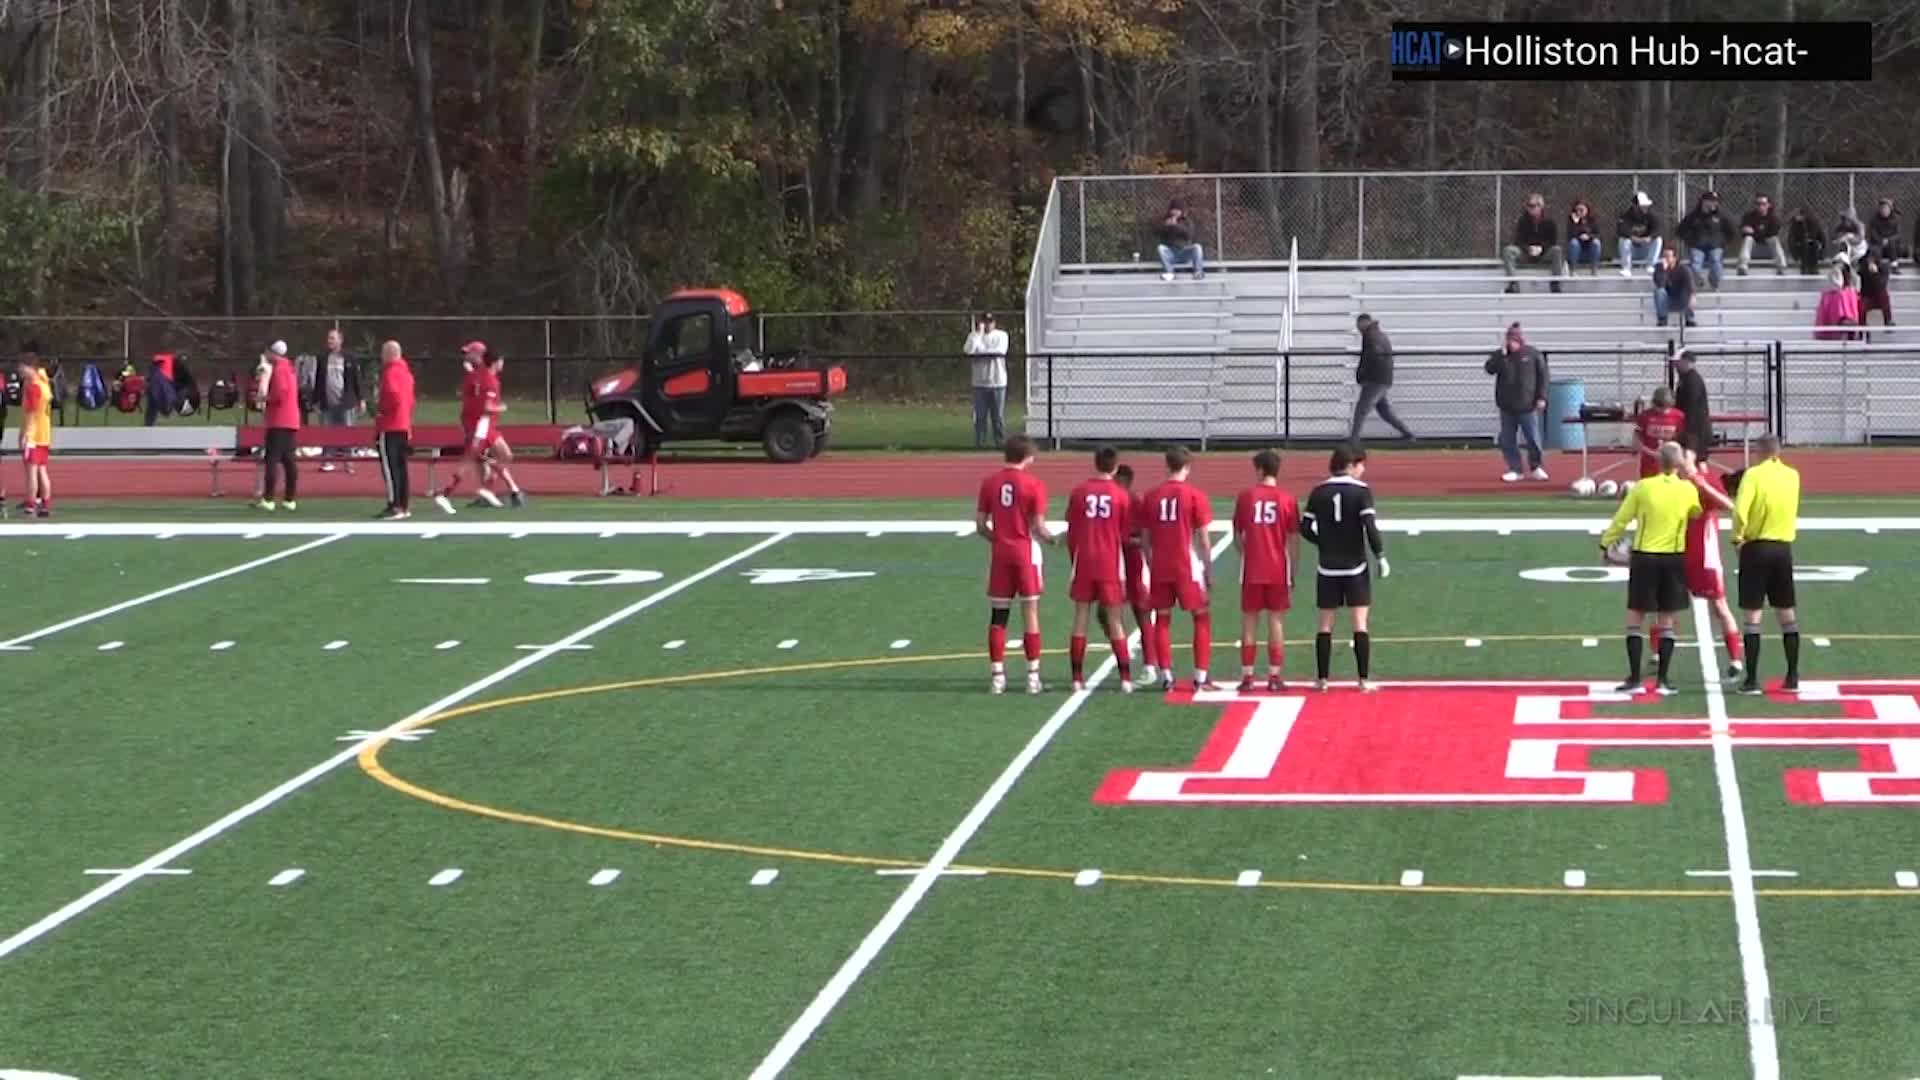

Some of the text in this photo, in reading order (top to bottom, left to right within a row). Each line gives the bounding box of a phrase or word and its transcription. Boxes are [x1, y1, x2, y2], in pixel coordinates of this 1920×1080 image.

[1001, 484, 1014, 508] 6
[1085, 493, 1113, 519] 35
[1332, 492, 1343, 522] 1
[1159, 497, 1178, 522] 11
[1253, 500, 1279, 524] 15
